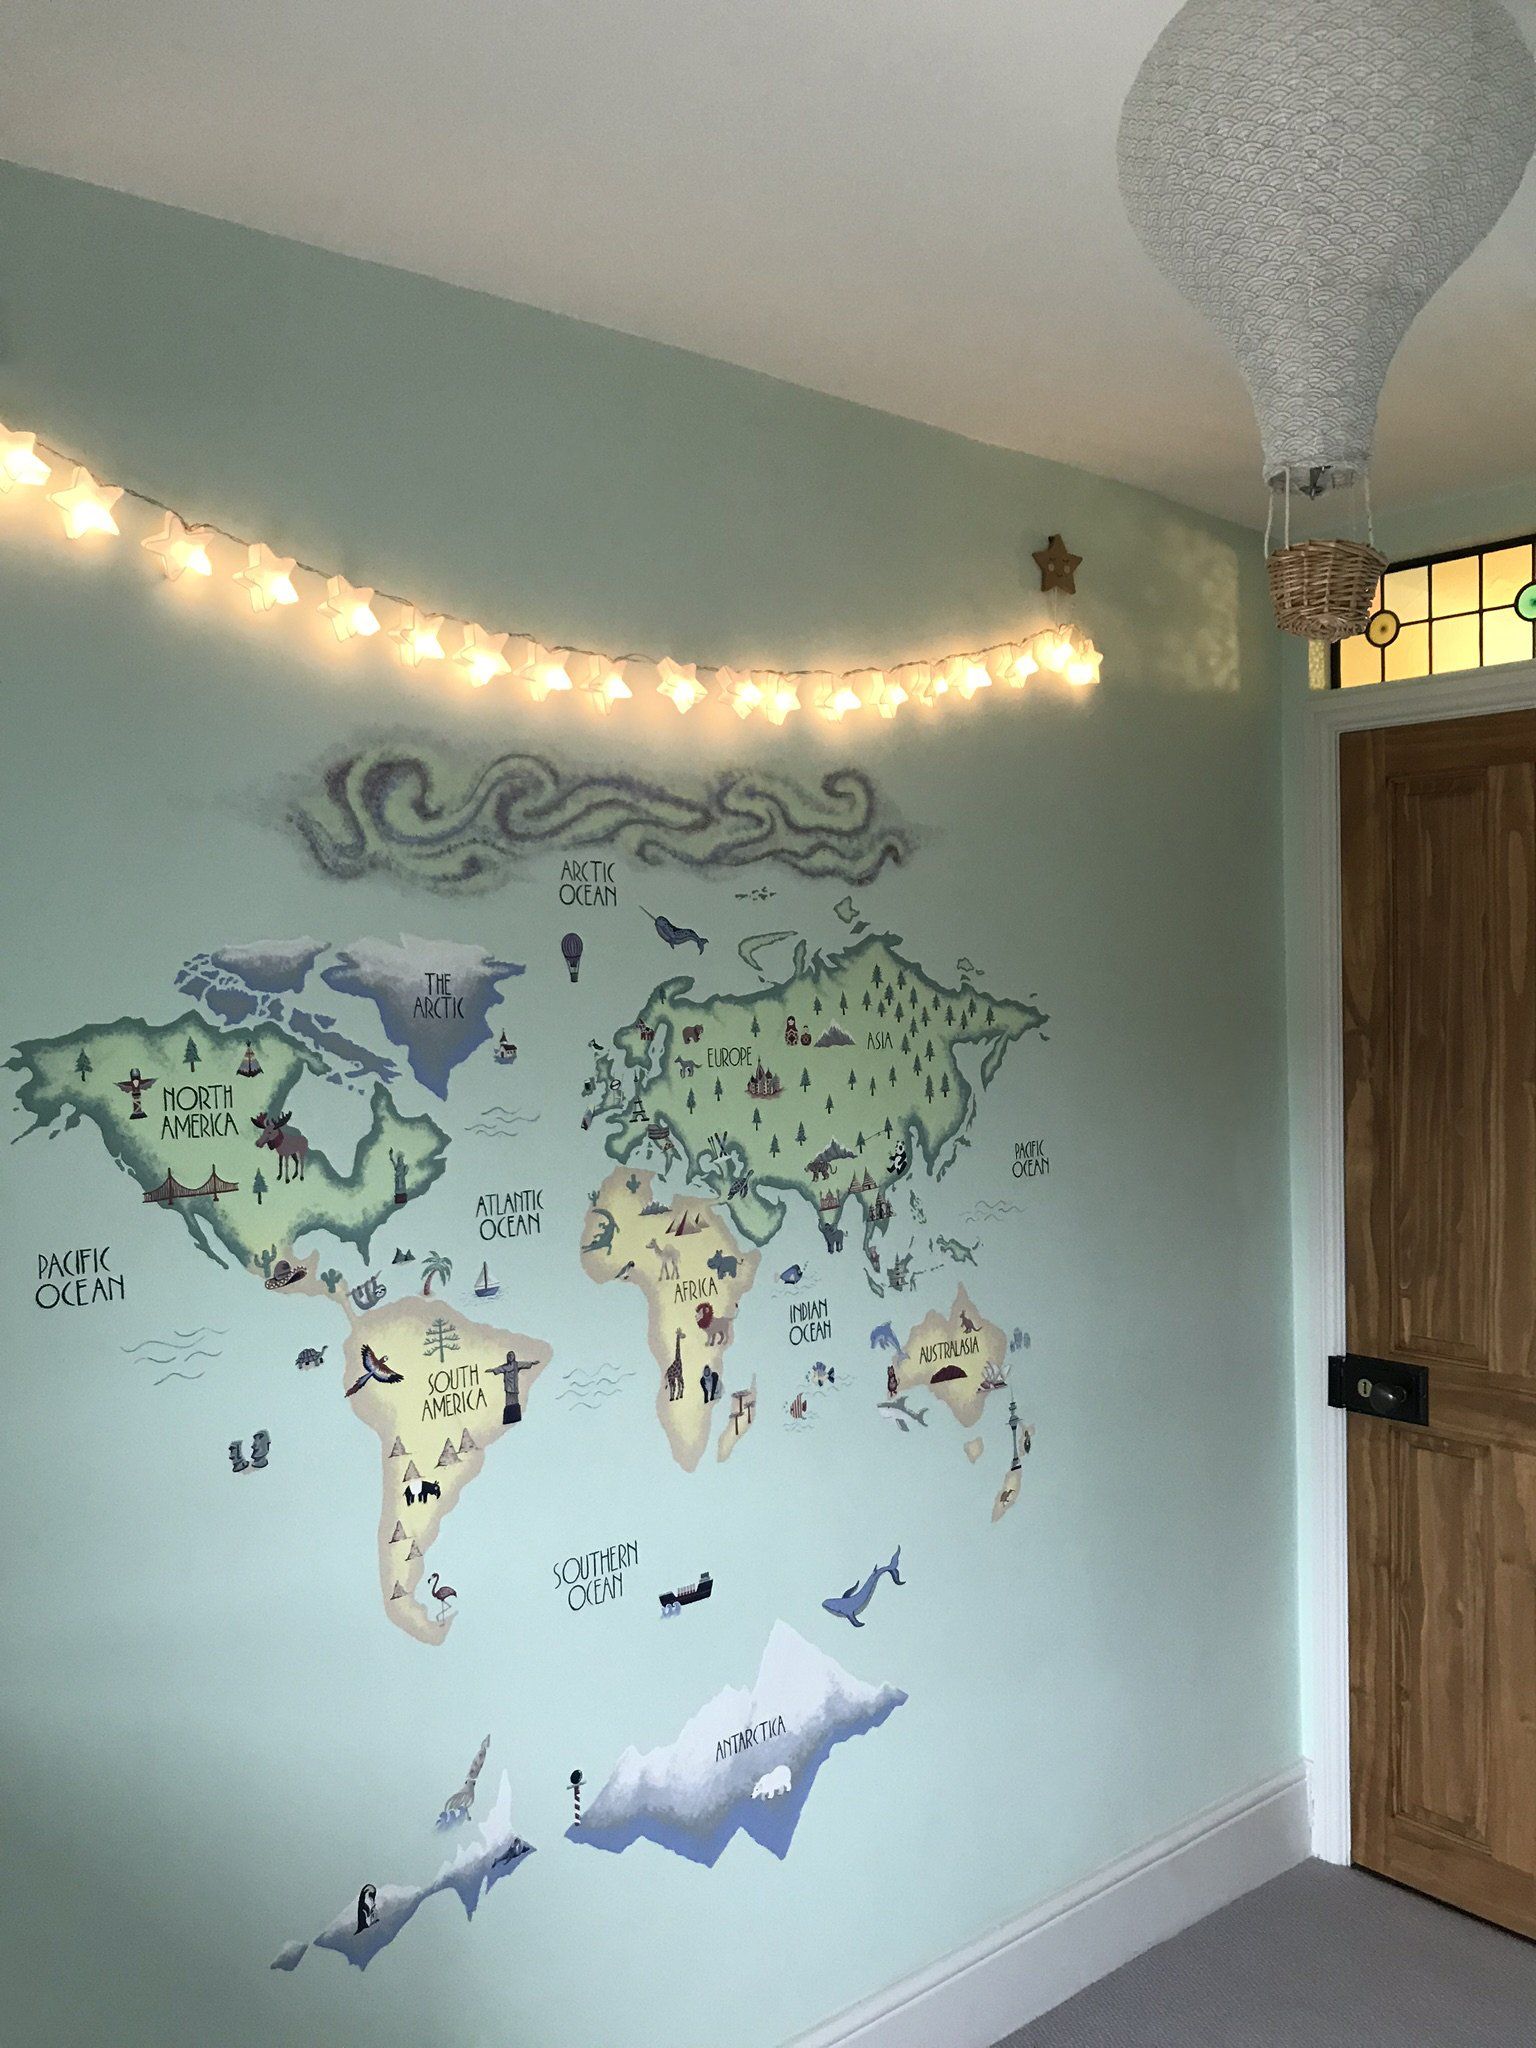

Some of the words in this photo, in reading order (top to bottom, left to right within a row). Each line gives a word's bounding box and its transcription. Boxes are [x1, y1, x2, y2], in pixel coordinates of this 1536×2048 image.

[560, 860, 616, 883] ARCTIC
[559, 883, 617, 906] OCEAN
[424, 972, 452, 997] THE
[412, 996, 465, 1020] ARCTIC
[867, 1030, 893, 1050] ASIA
[707, 1047, 752, 1068] EUROPE
[163, 1084, 234, 1112] NORTH
[161, 1113, 239, 1140] AMERICA
[1014, 1140, 1045, 1157] PACIFIC
[1012, 1157, 1050, 1178] OCEAN
[476, 1190, 544, 1218] ATLANTIC
[480, 1213, 541, 1241] OCEAN
[38, 1246, 112, 1279] PACIFIC
[35, 1275, 125, 1309] OCEAN
[674, 1277, 718, 1303] AFRICA
[789, 1299, 828, 1323] INDIAN
[789, 1320, 831, 1346] OCEAN
[919, 1339, 980, 1364] AUSTRALASIA
[427, 1364, 481, 1395] SOUTH
[421, 1387, 488, 1421] AMERICA
[553, 1540, 638, 1589] SOUTHERN
[567, 1573, 624, 1611] OCEAN
[715, 1715, 787, 1762] ANTARCTICA
